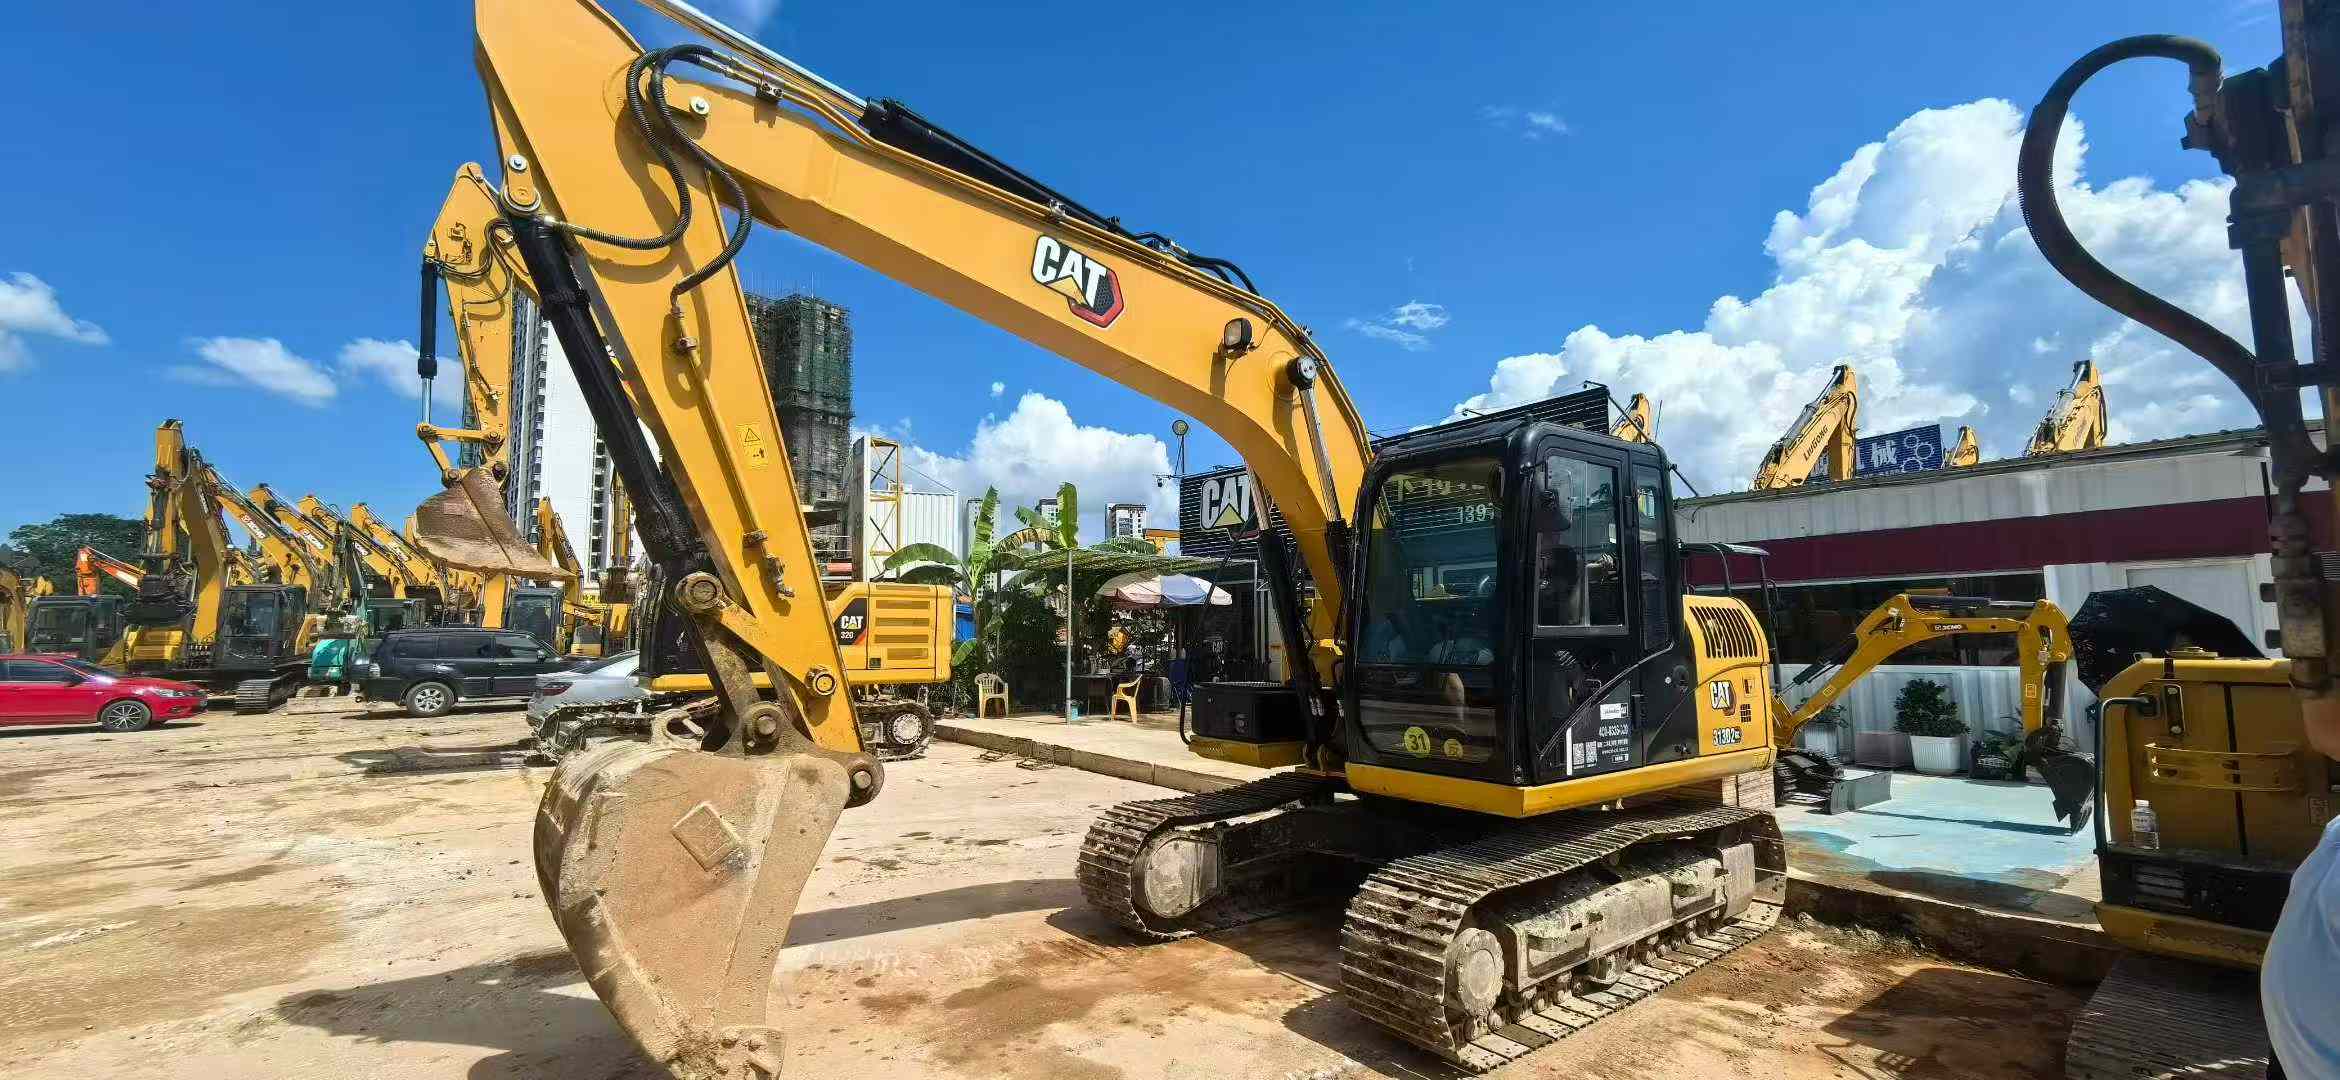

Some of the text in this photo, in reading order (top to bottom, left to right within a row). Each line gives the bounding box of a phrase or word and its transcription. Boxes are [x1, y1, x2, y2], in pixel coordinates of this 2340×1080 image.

[1033, 236, 1107, 308] CAT
[1201, 475, 1252, 529] CAT
[841, 615, 863, 630] CAT
[1709, 681, 1730, 709] CAT
